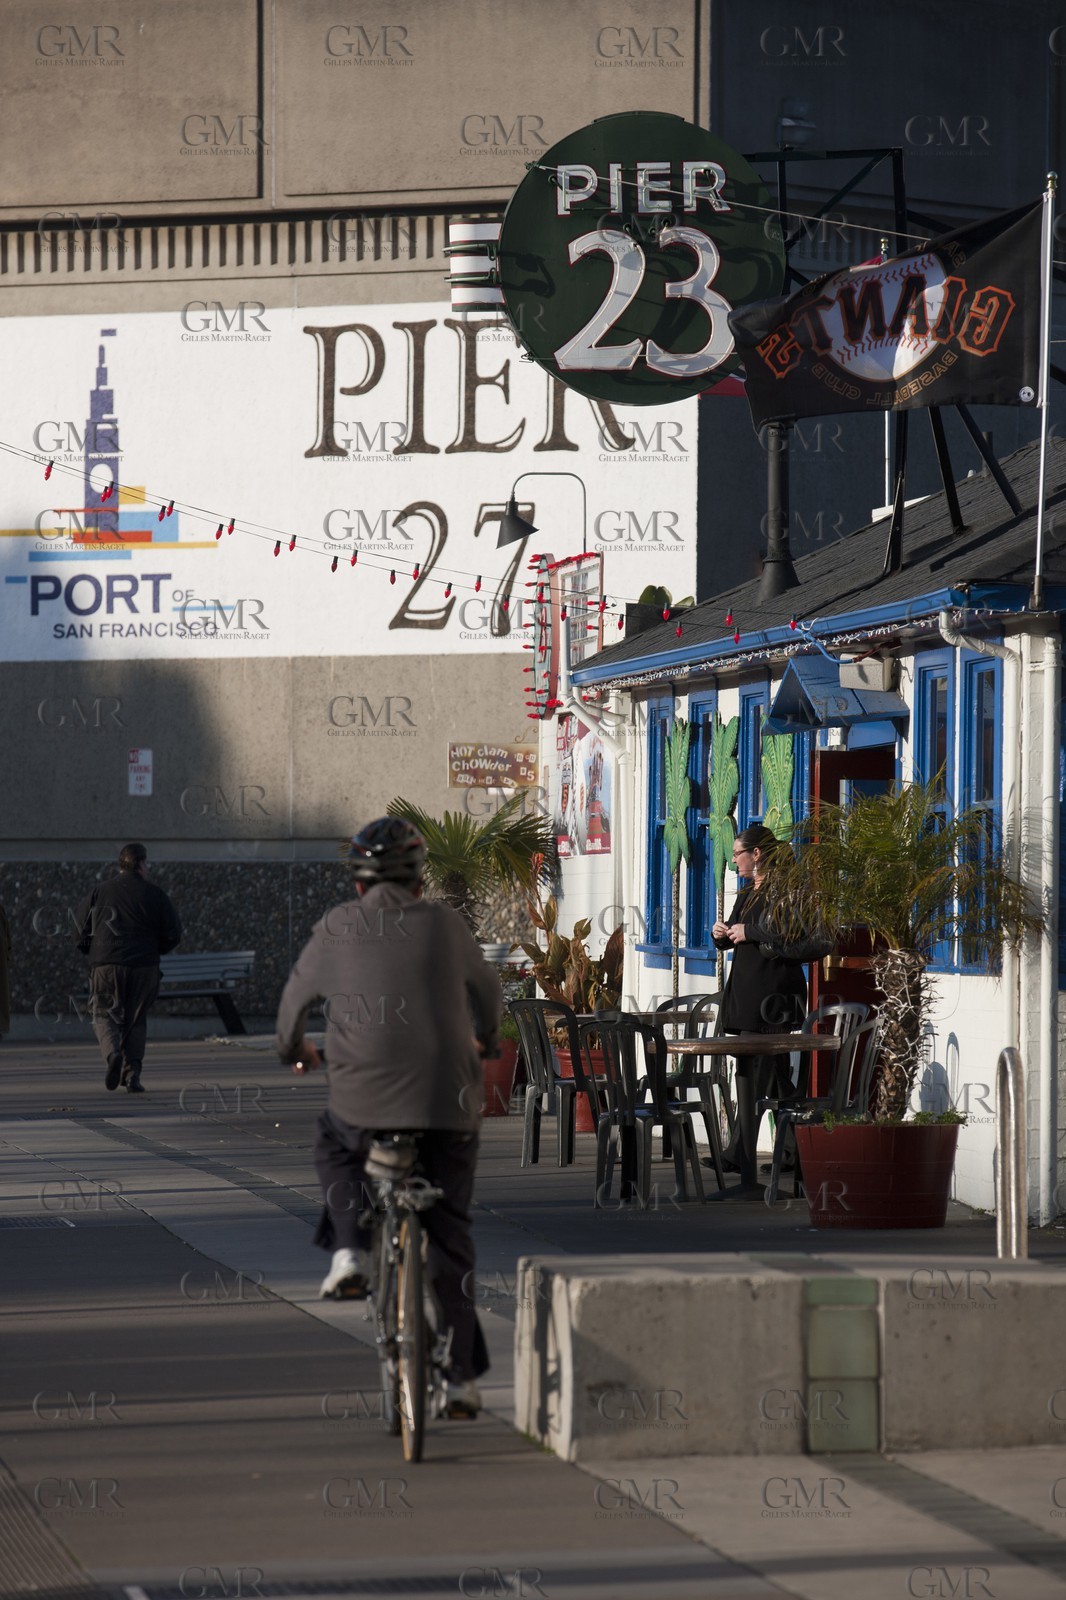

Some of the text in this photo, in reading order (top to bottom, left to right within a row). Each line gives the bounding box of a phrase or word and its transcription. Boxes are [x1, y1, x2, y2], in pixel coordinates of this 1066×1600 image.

[556, 161, 733, 215] PIER
[553, 225, 736, 378] 23
[388, 500, 536, 637] 27
[30, 573, 195, 616] PORT OF
[53, 621, 218, 639] SAN FRANCISCO
[451, 745, 475, 758] HOT
